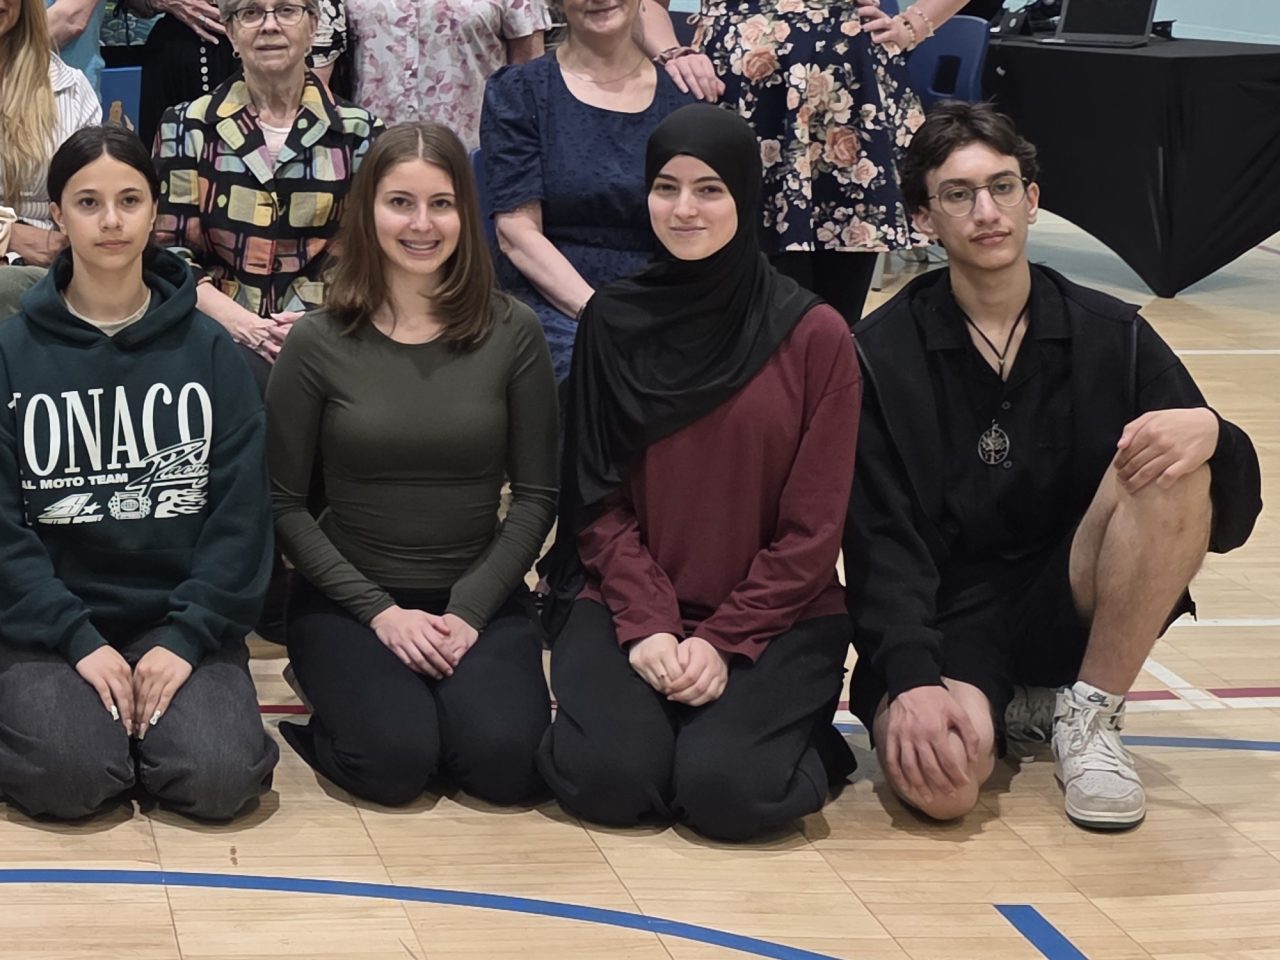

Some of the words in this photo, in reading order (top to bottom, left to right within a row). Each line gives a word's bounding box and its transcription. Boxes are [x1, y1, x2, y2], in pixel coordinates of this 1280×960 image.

[7, 381, 213, 477] ONACO
[40, 476, 85, 490] MOTO
[88, 473, 129, 486] TEAM
